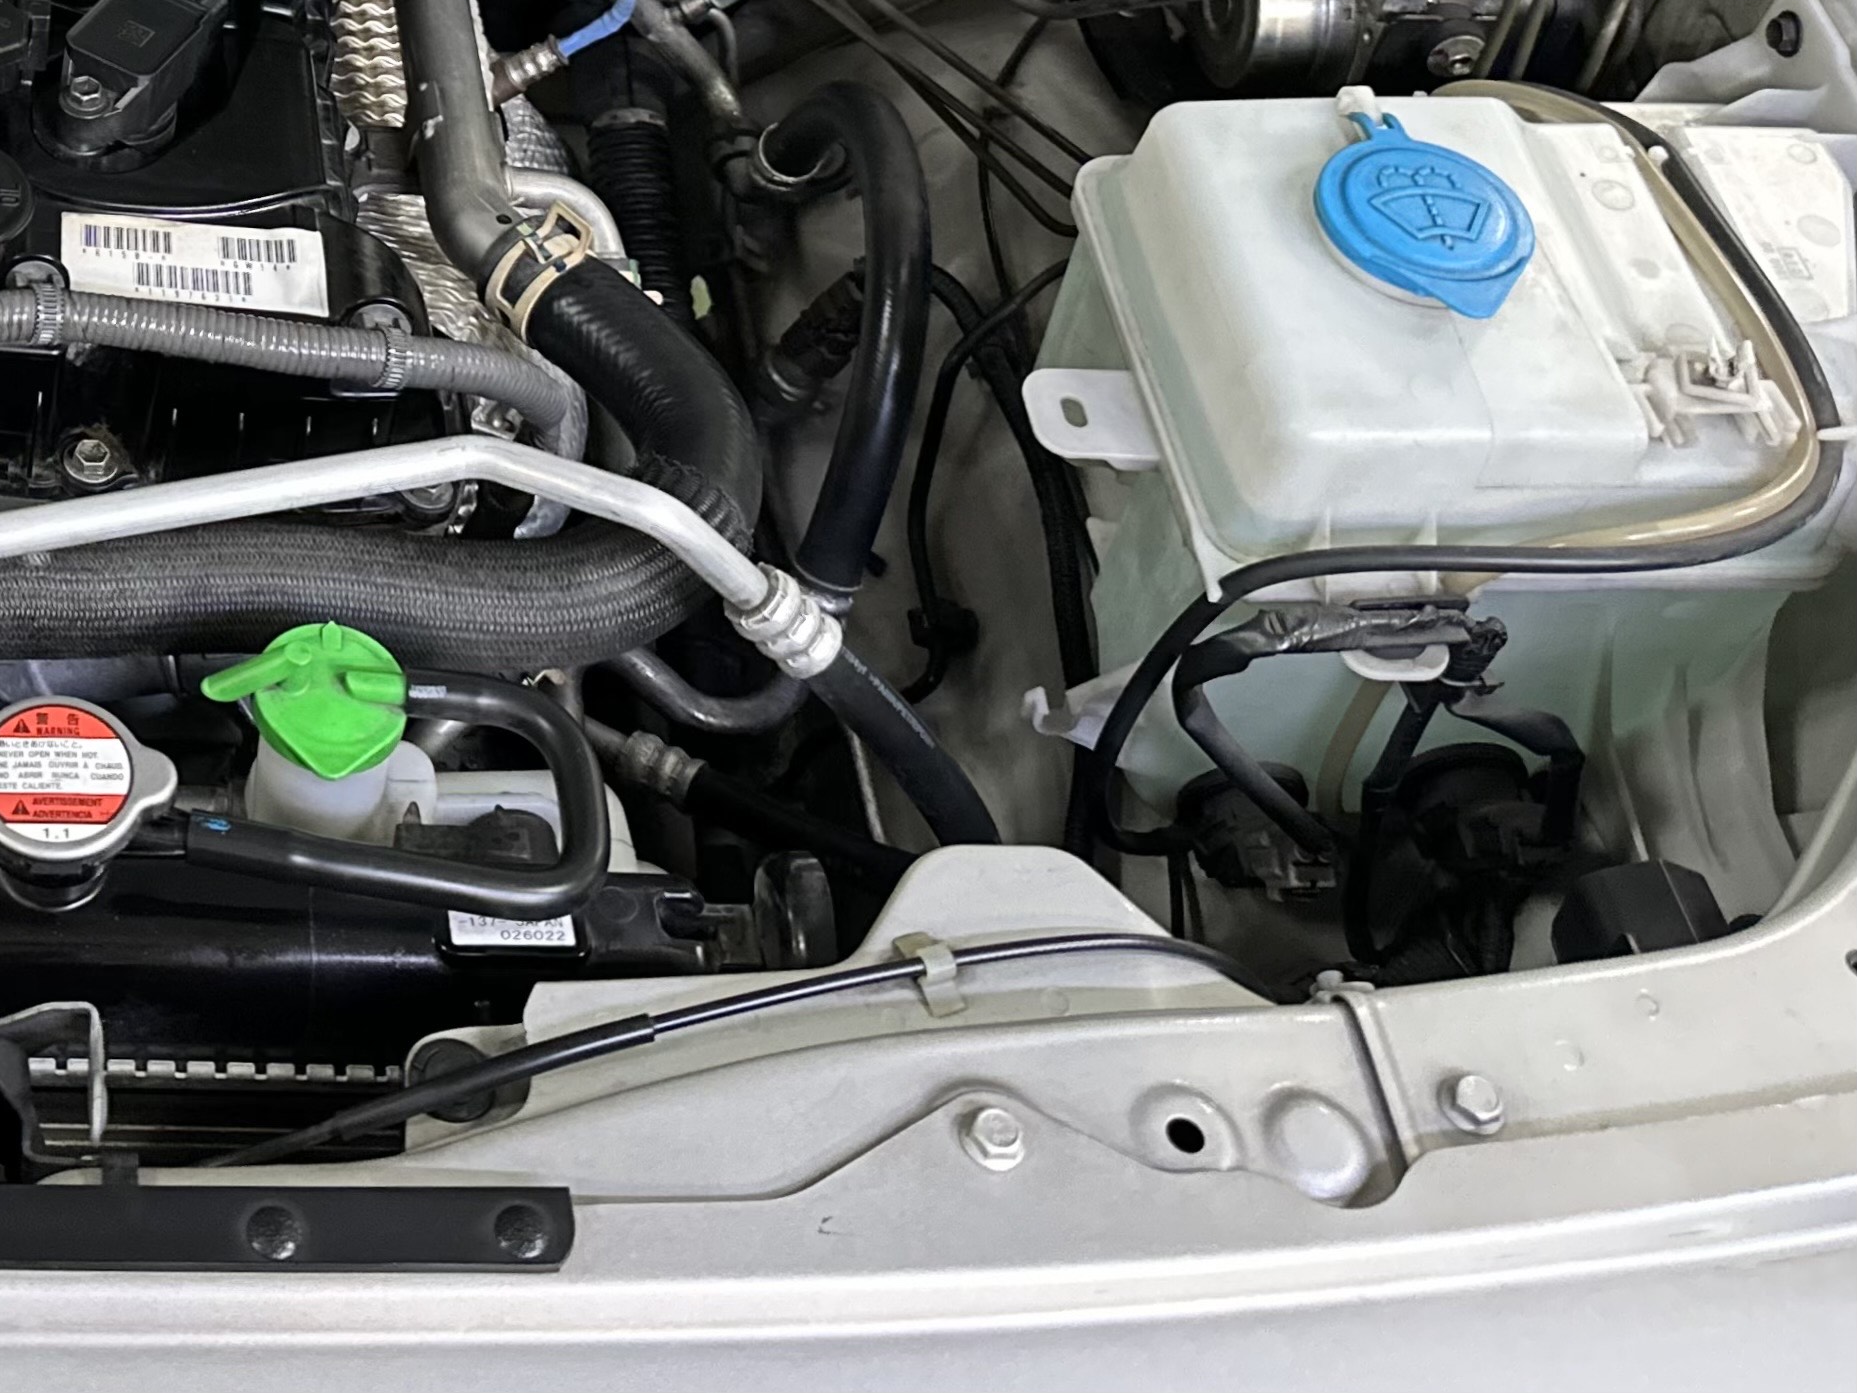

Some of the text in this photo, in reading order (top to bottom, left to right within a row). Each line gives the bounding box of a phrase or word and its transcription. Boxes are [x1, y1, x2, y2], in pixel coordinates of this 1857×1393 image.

[36, 726, 81, 736] WARNING
[28, 750, 50, 758] OPEN
[54, 750, 78, 758] WHEN
[12, 760, 42, 769] JAMAIS
[48, 761, 79, 769] OUVRIR
[18, 771, 43, 779] ABRIR
[51, 771, 79, 779] NUNCA
[90, 772, 124, 780] CUANDO
[32, 797, 104, 807] AVERTISSEMENT
[32, 810, 93, 819] ADVERTENCIA
[500, 929, 566, 942] 026022
